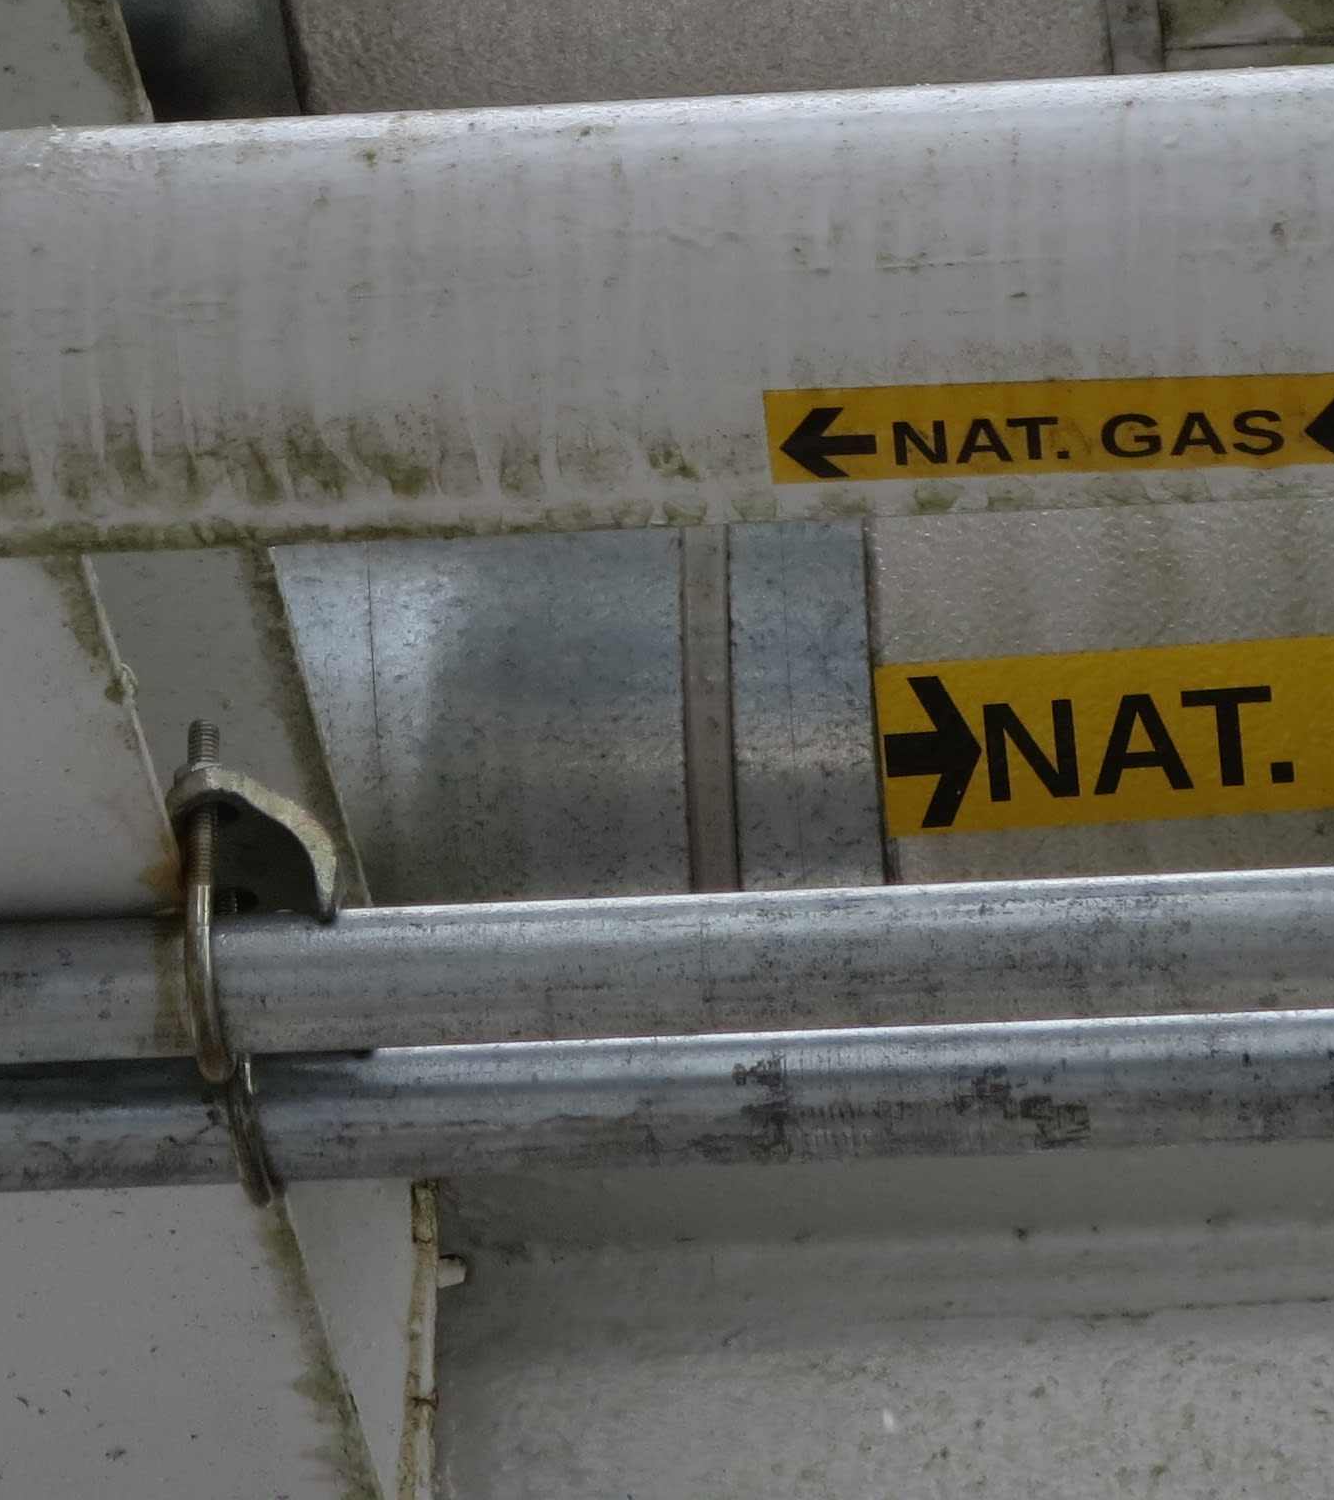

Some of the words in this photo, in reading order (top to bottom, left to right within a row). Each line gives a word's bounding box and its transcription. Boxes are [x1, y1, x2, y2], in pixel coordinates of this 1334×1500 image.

[892, 416, 1070, 466] NAT.
[1100, 409, 1285, 459] GAS
[982, 685, 1295, 803] NAT.
